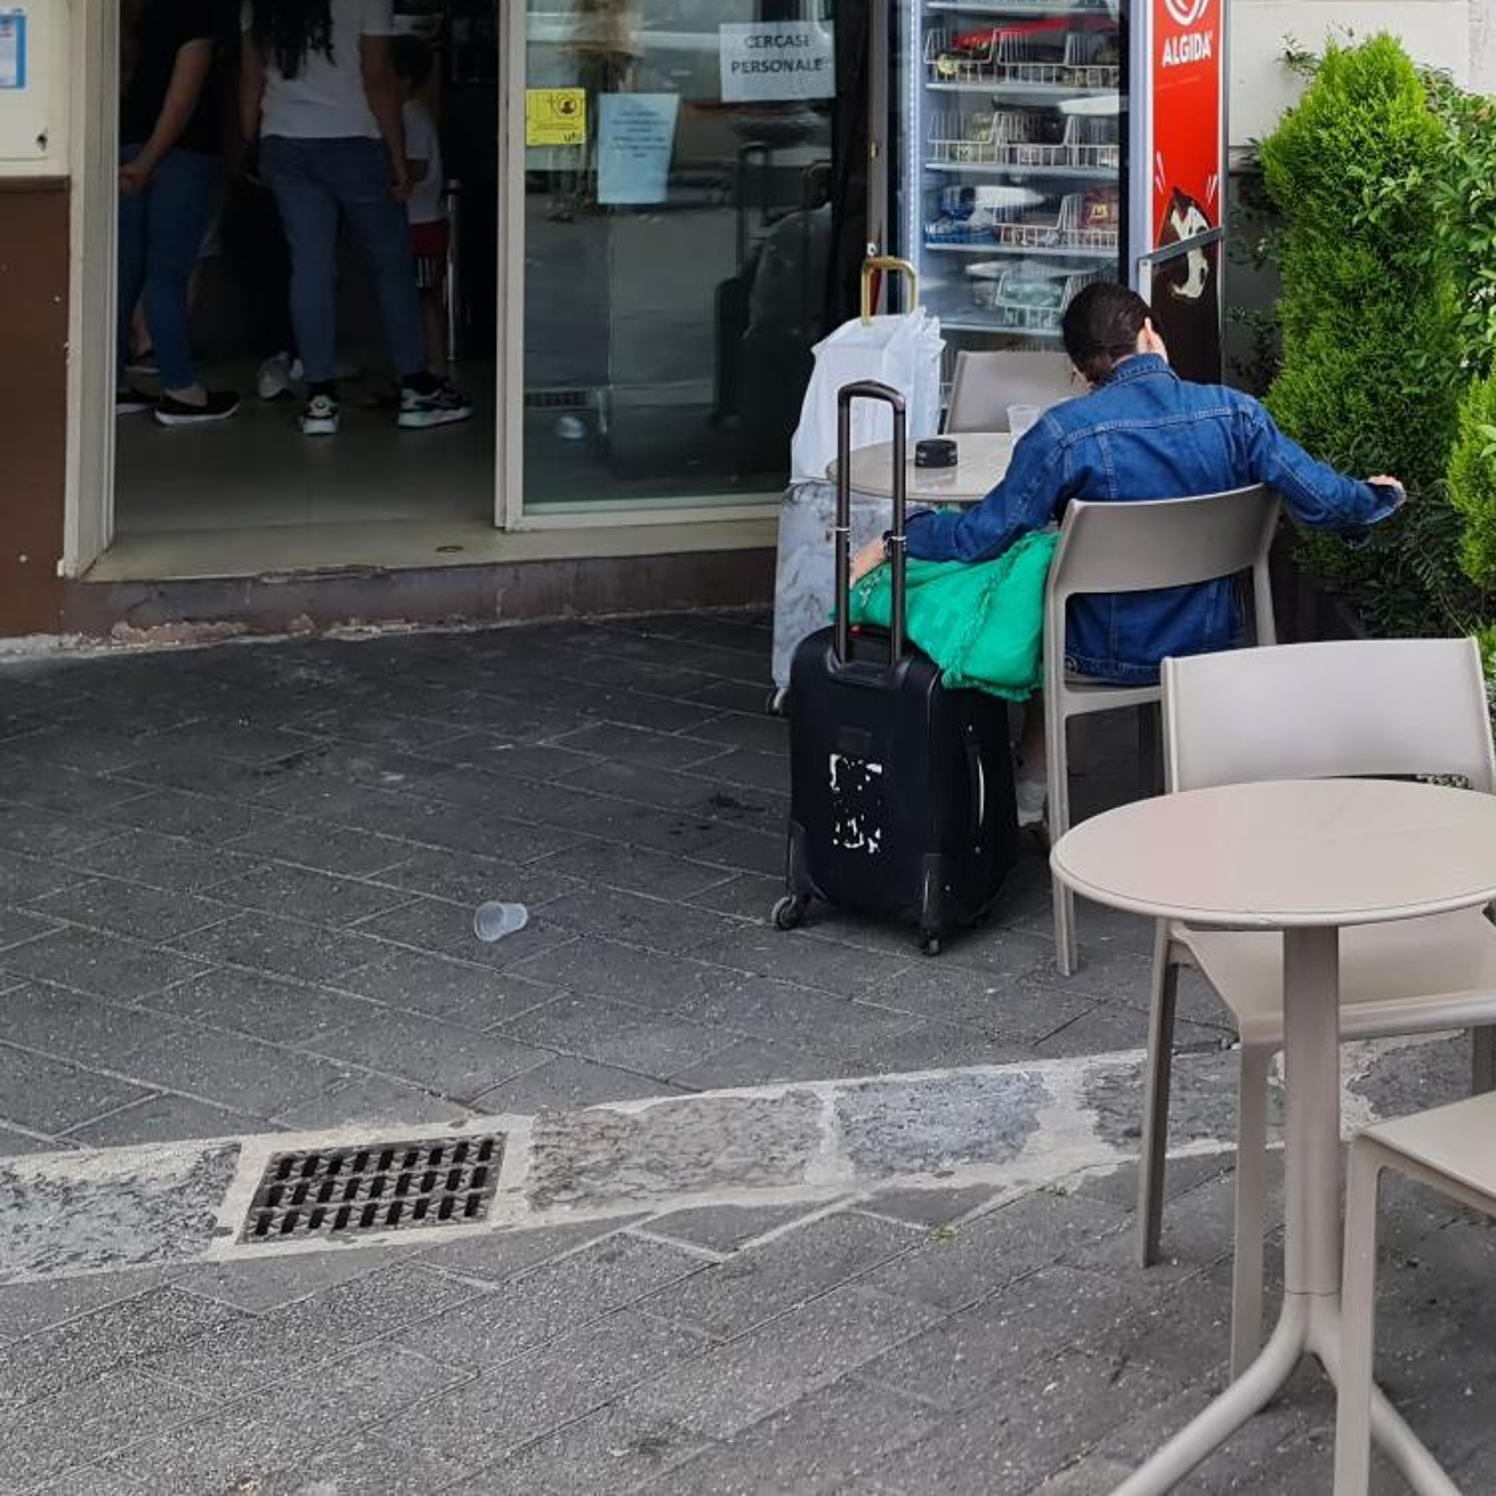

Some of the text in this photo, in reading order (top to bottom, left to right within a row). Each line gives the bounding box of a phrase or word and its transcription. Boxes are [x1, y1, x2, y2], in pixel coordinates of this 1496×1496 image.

[744, 33, 811, 51] CERCASI
[1161, 32, 1213, 68] ALGIDA
[730, 57, 824, 75] PERSONALE
